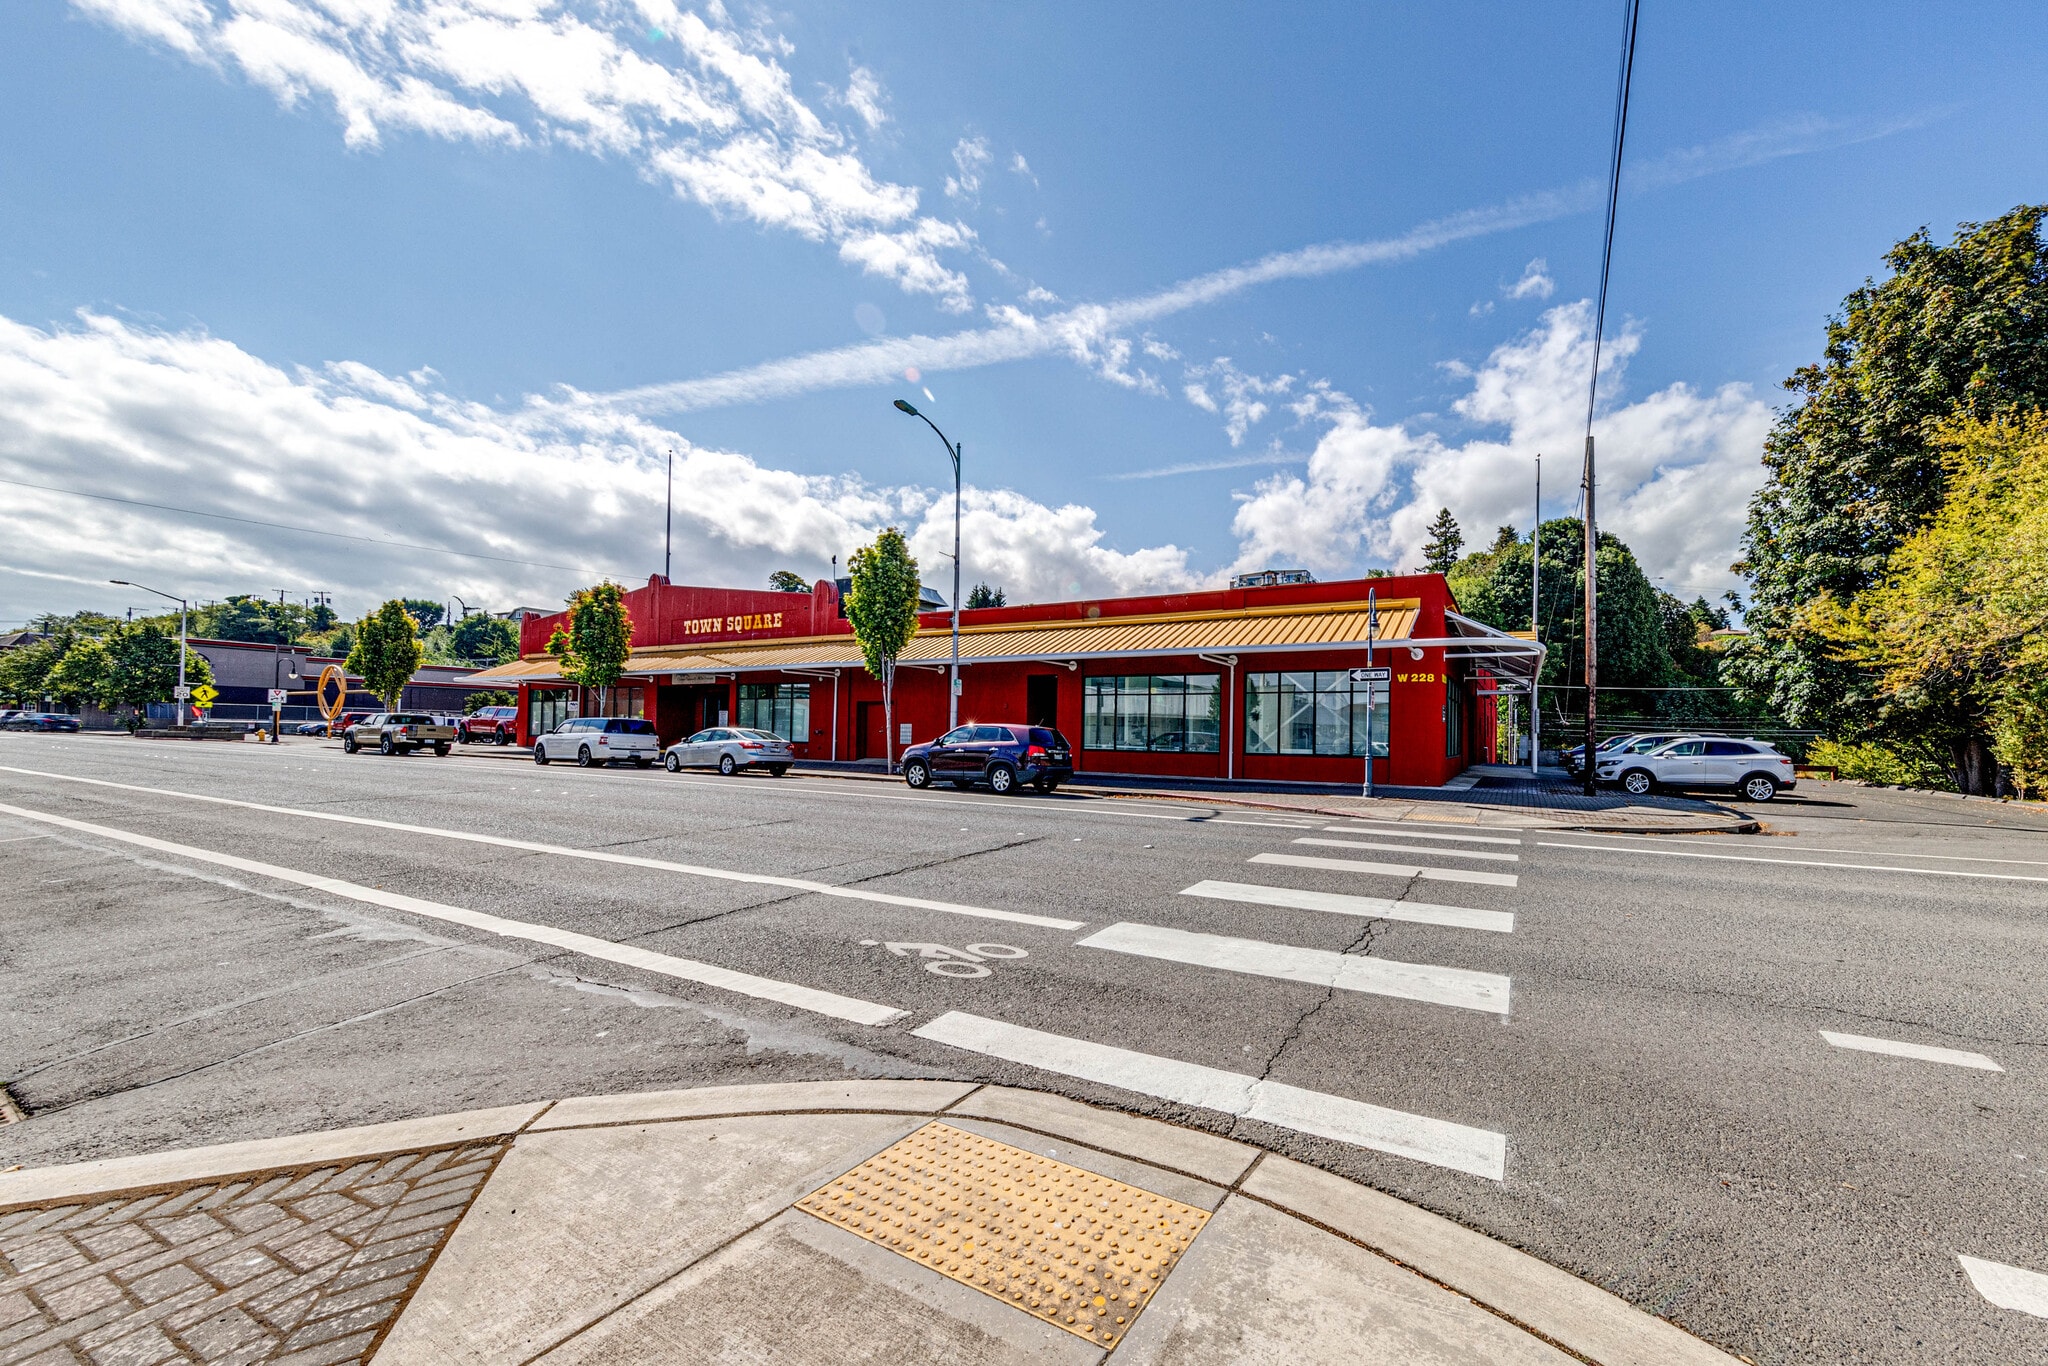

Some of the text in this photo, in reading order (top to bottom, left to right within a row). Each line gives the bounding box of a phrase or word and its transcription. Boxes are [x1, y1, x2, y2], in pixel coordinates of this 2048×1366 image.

[683, 612, 783, 635] TOWN SQUARE
[1397, 673, 1408, 683] W
[1410, 673, 1435, 683] 228
